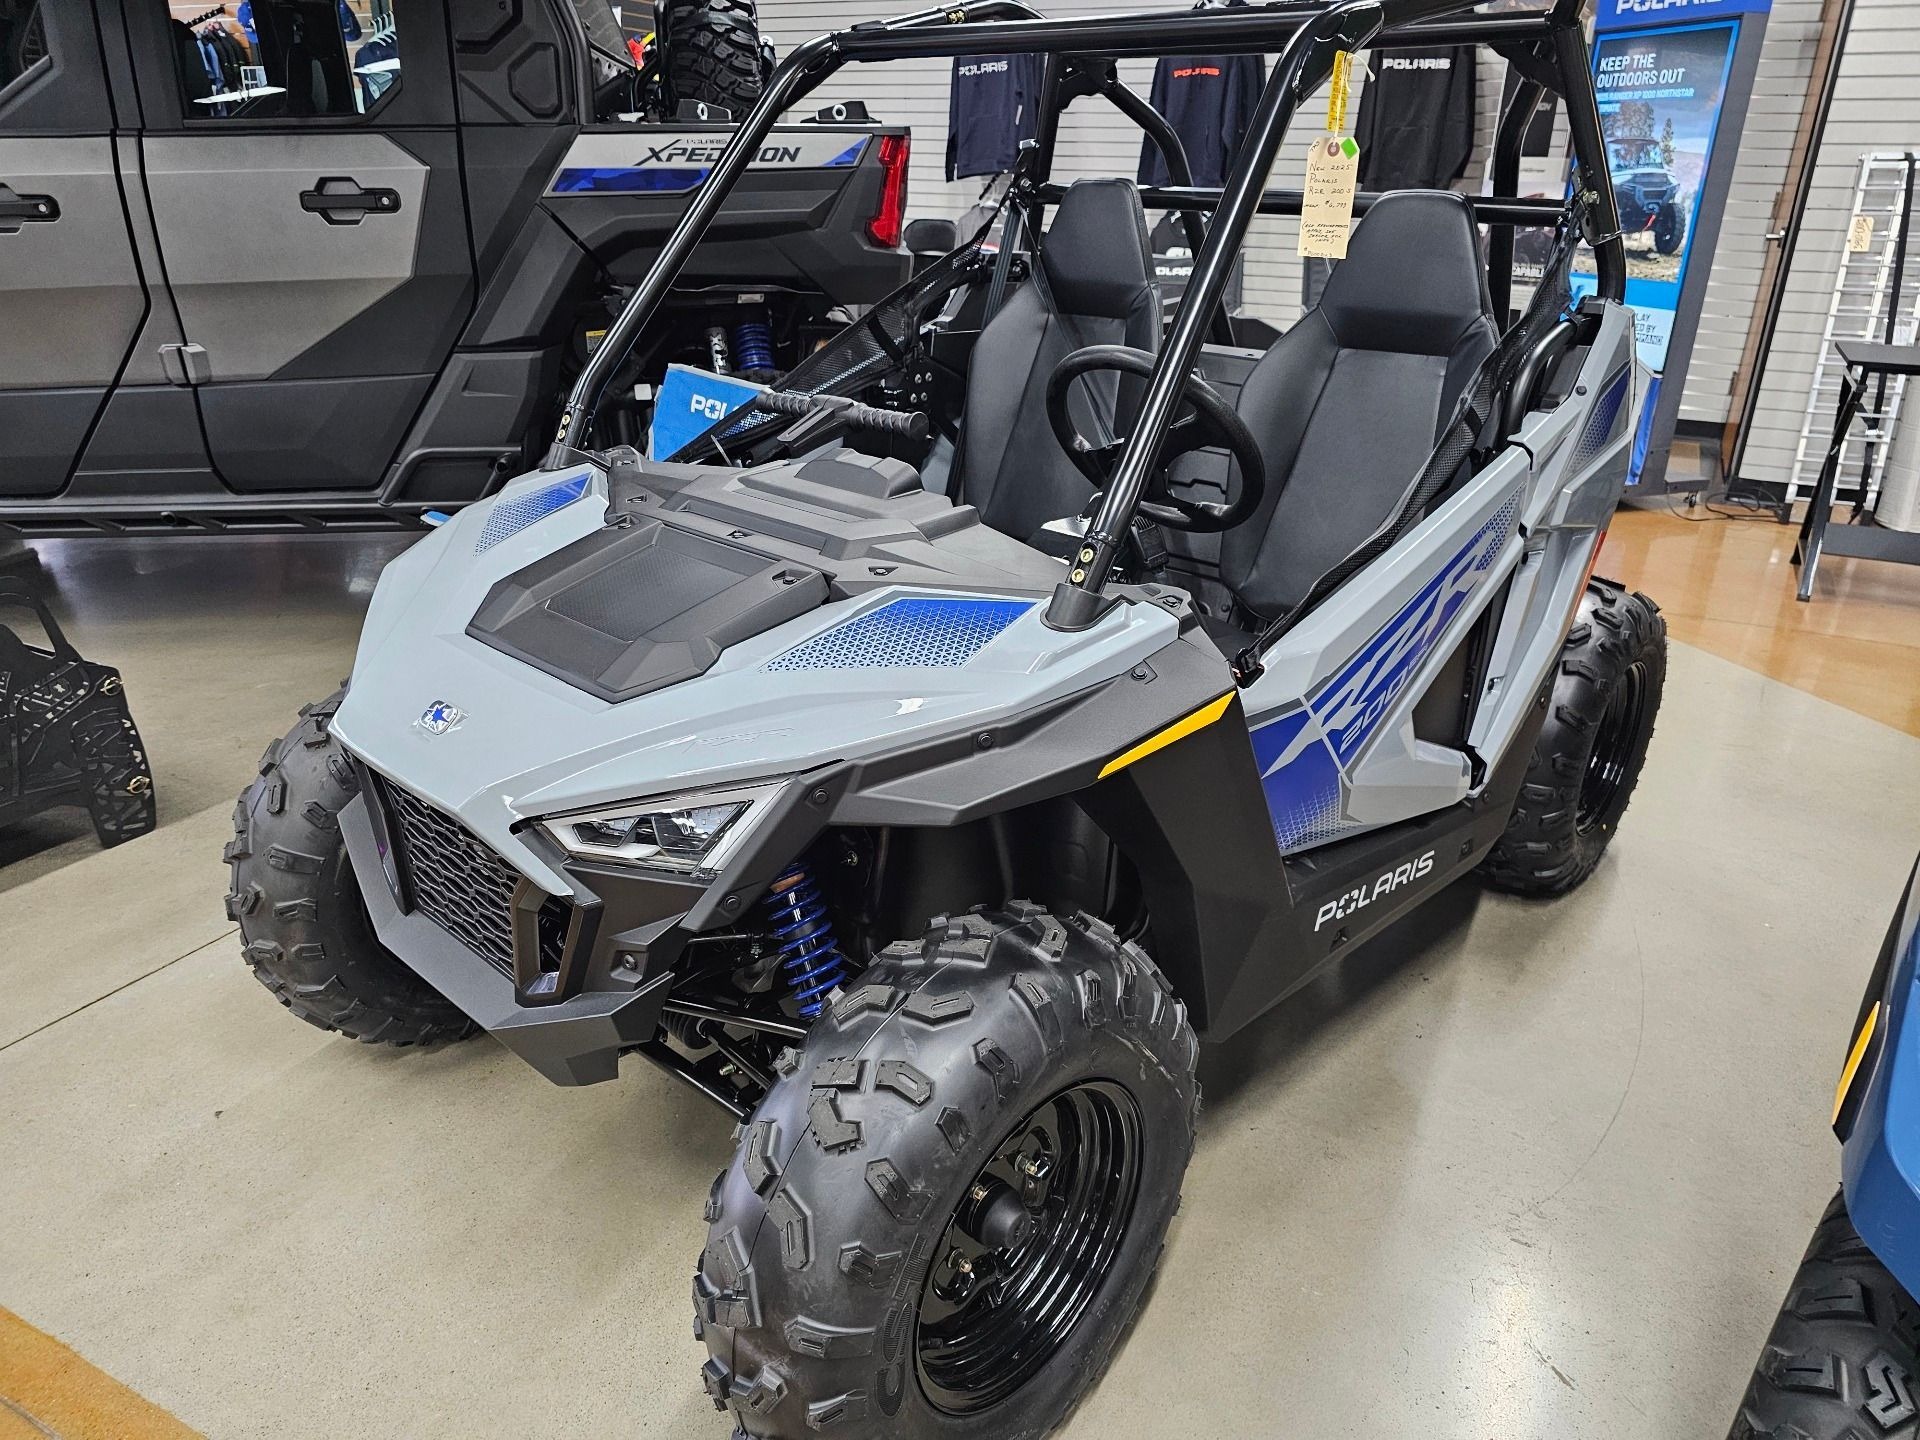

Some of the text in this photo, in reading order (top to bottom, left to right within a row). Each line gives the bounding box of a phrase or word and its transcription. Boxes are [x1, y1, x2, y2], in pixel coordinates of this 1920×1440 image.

[958, 61, 1008, 76] POLARIS
[1382, 58, 1451, 70] POLARIS
[1600, 53, 1656, 71] KEEP THE
[1596, 68, 1686, 88] OUTDOORS OUT
[1331, 163, 1353, 171] 2025
[1314, 850, 1435, 932] POLARIS
